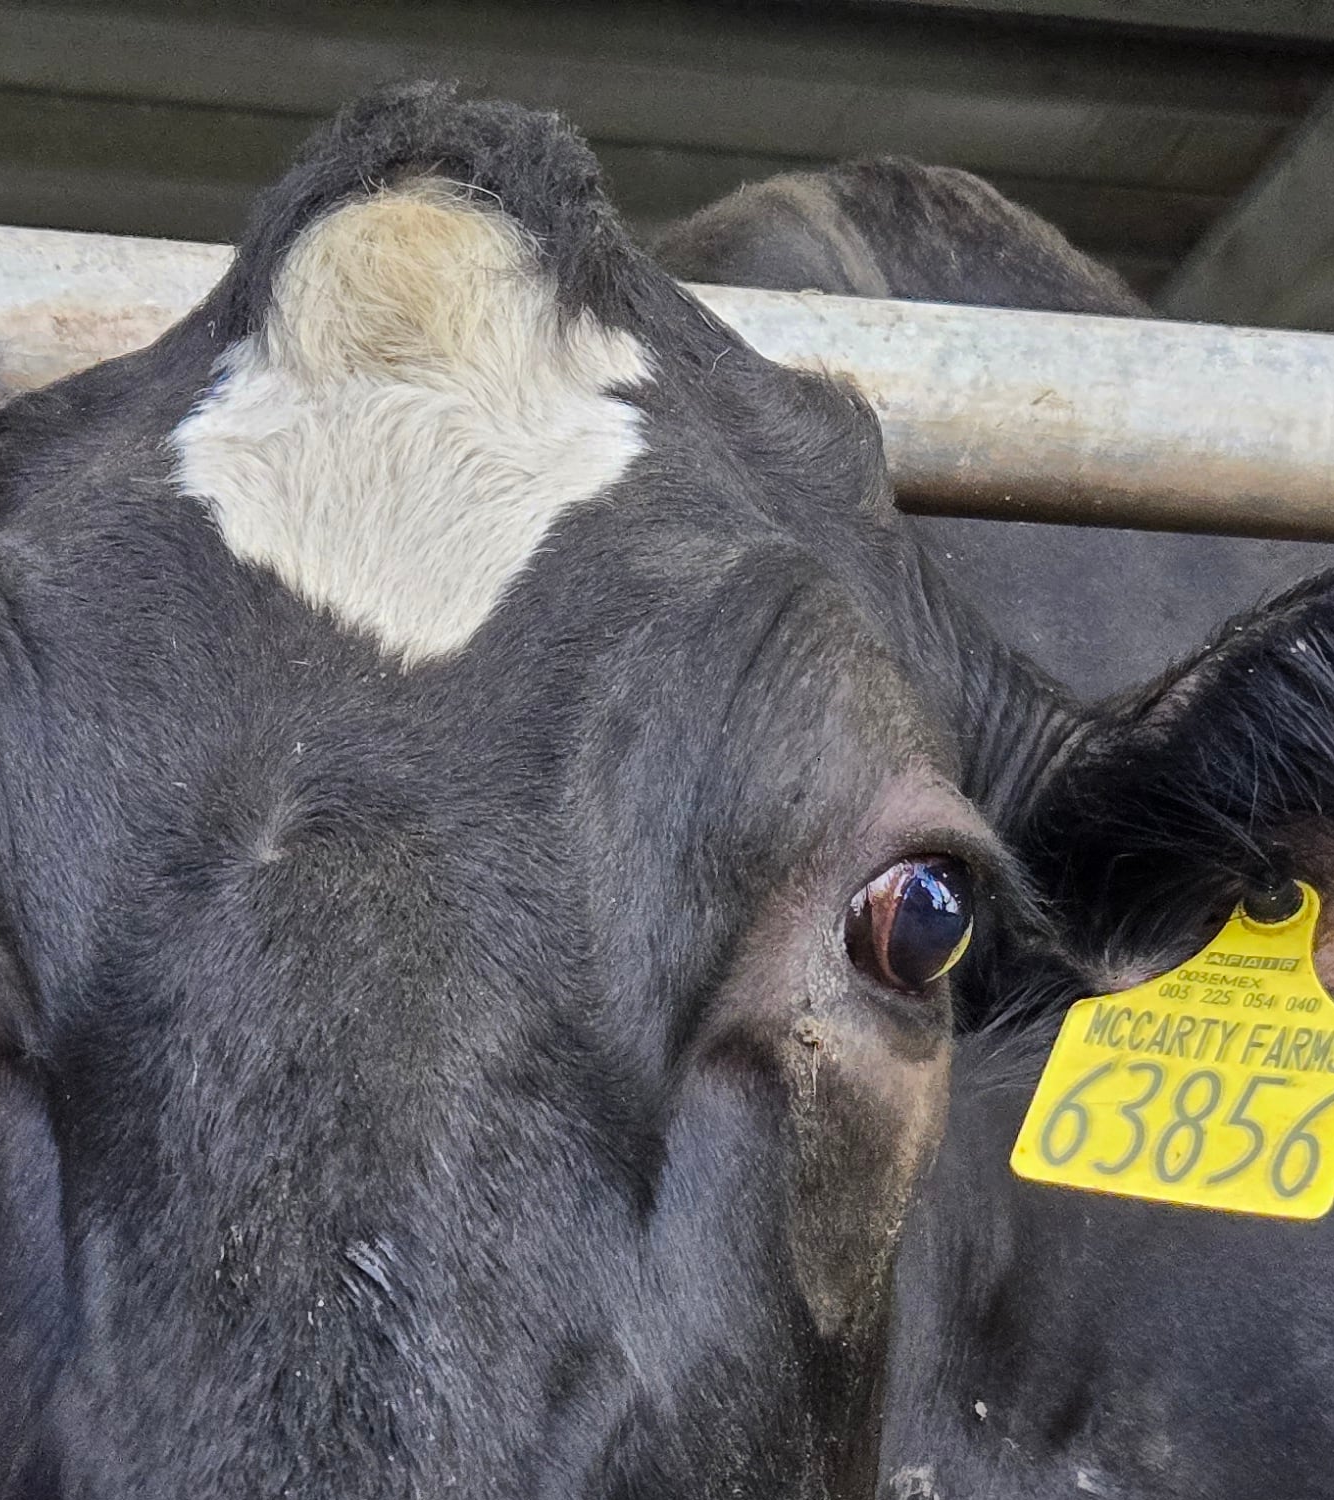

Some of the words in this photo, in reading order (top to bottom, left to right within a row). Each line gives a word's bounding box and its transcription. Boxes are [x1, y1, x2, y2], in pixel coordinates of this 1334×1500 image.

[1158, 982, 1191, 1000] 003
[1199, 988, 1234, 1006] 225
[1242, 992, 1276, 1010] 054
[1285, 996, 1320, 1013] 040
[1082, 1003, 1242, 1063] MCCARTY
